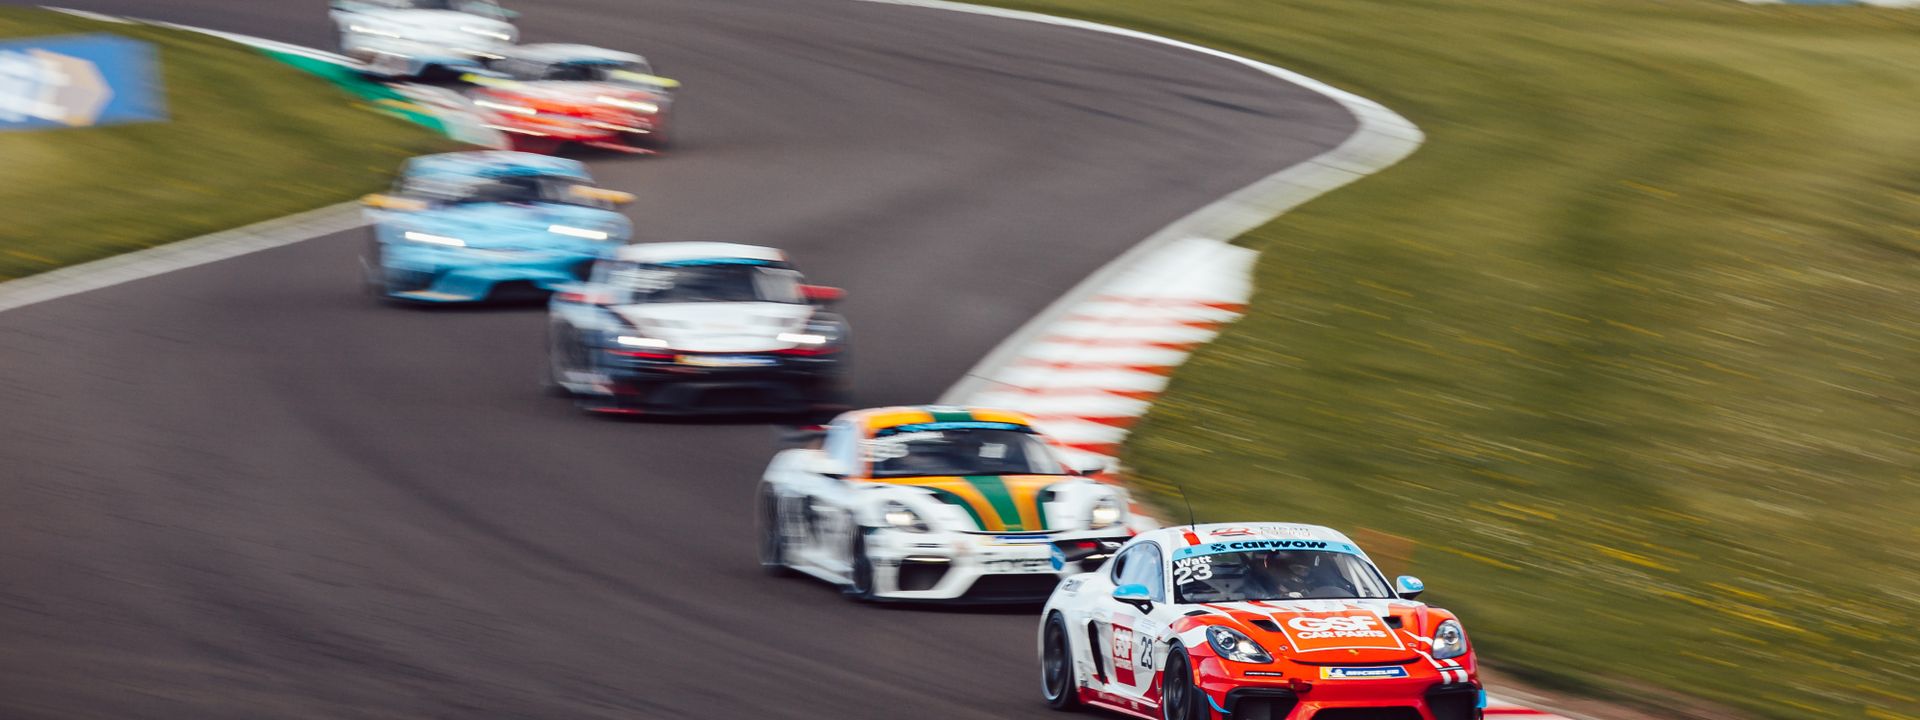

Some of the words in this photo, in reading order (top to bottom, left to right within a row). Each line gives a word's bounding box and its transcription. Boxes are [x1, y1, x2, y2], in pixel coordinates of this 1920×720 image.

[1230, 541, 1327, 549] carwow
[1174, 555, 1213, 568] Watt
[1173, 563, 1213, 586] 23
[1288, 616, 1377, 631] GSF
[1336, 630, 1387, 638] PARTS
[1113, 628, 1132, 660] GSF
[1141, 636, 1153, 670] 23
